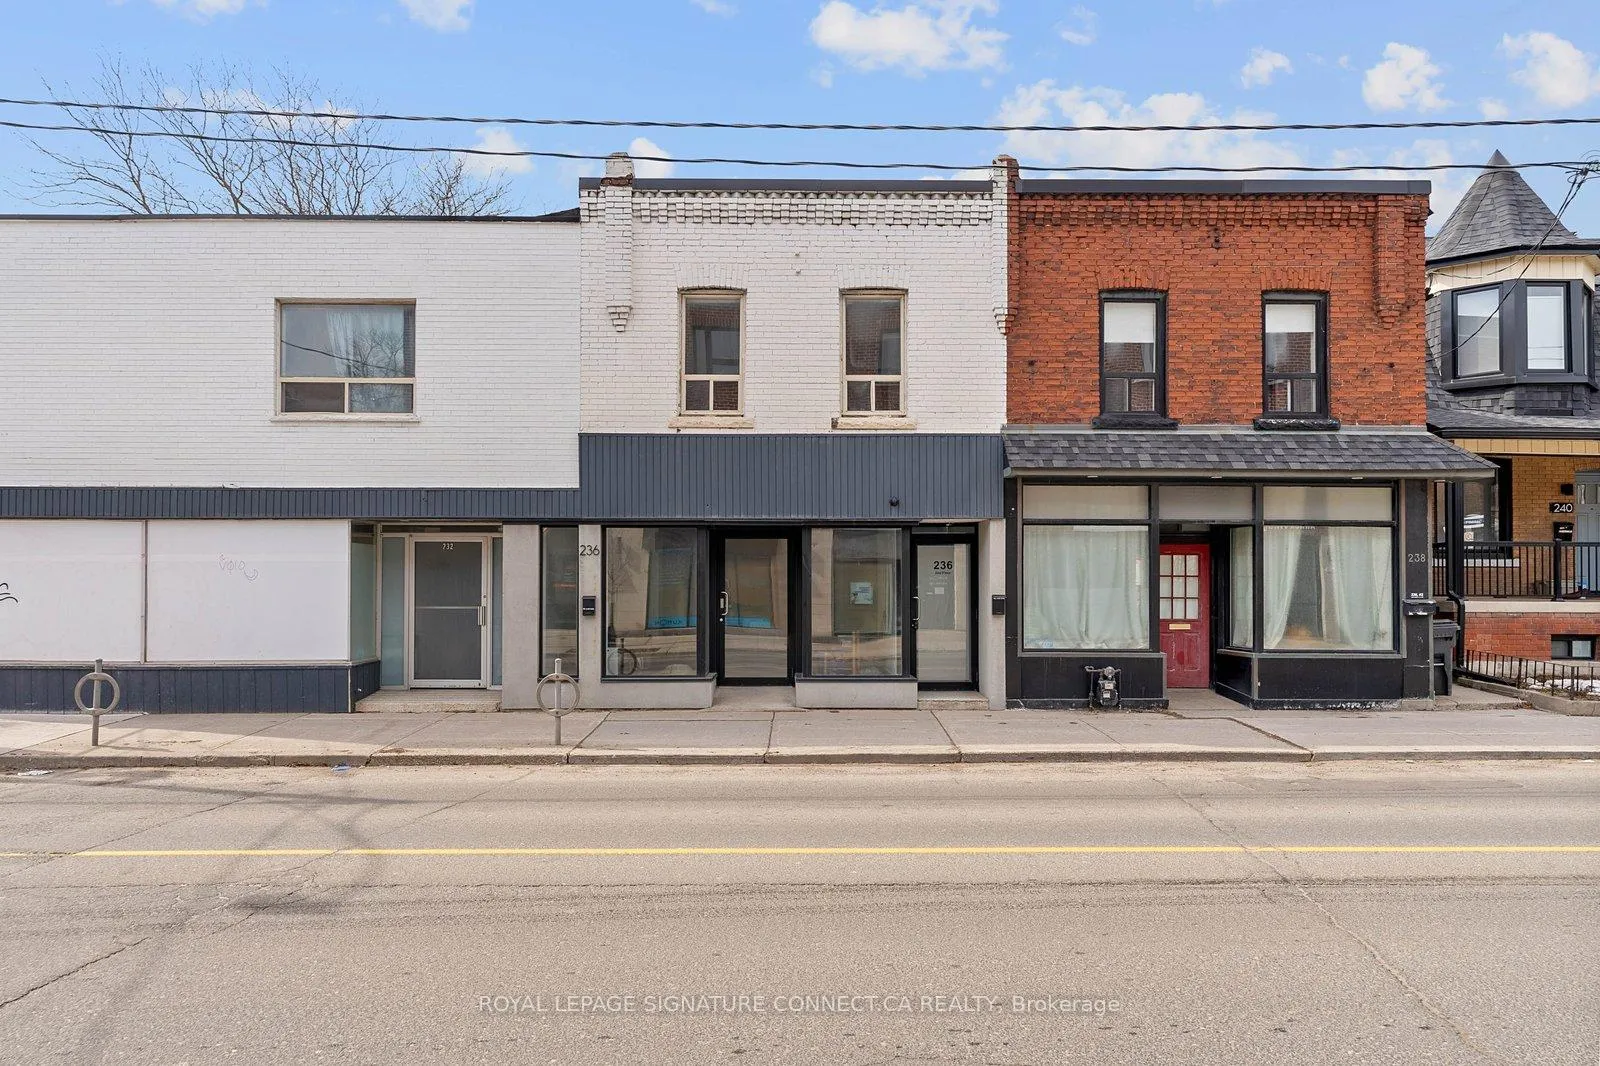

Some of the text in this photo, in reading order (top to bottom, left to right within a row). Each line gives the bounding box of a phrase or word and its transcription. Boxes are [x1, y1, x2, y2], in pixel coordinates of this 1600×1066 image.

[1553, 503, 1573, 513] 240
[580, 544, 600, 556] 236
[1408, 553, 1426, 563] 238
[933, 560, 953, 570] 236
